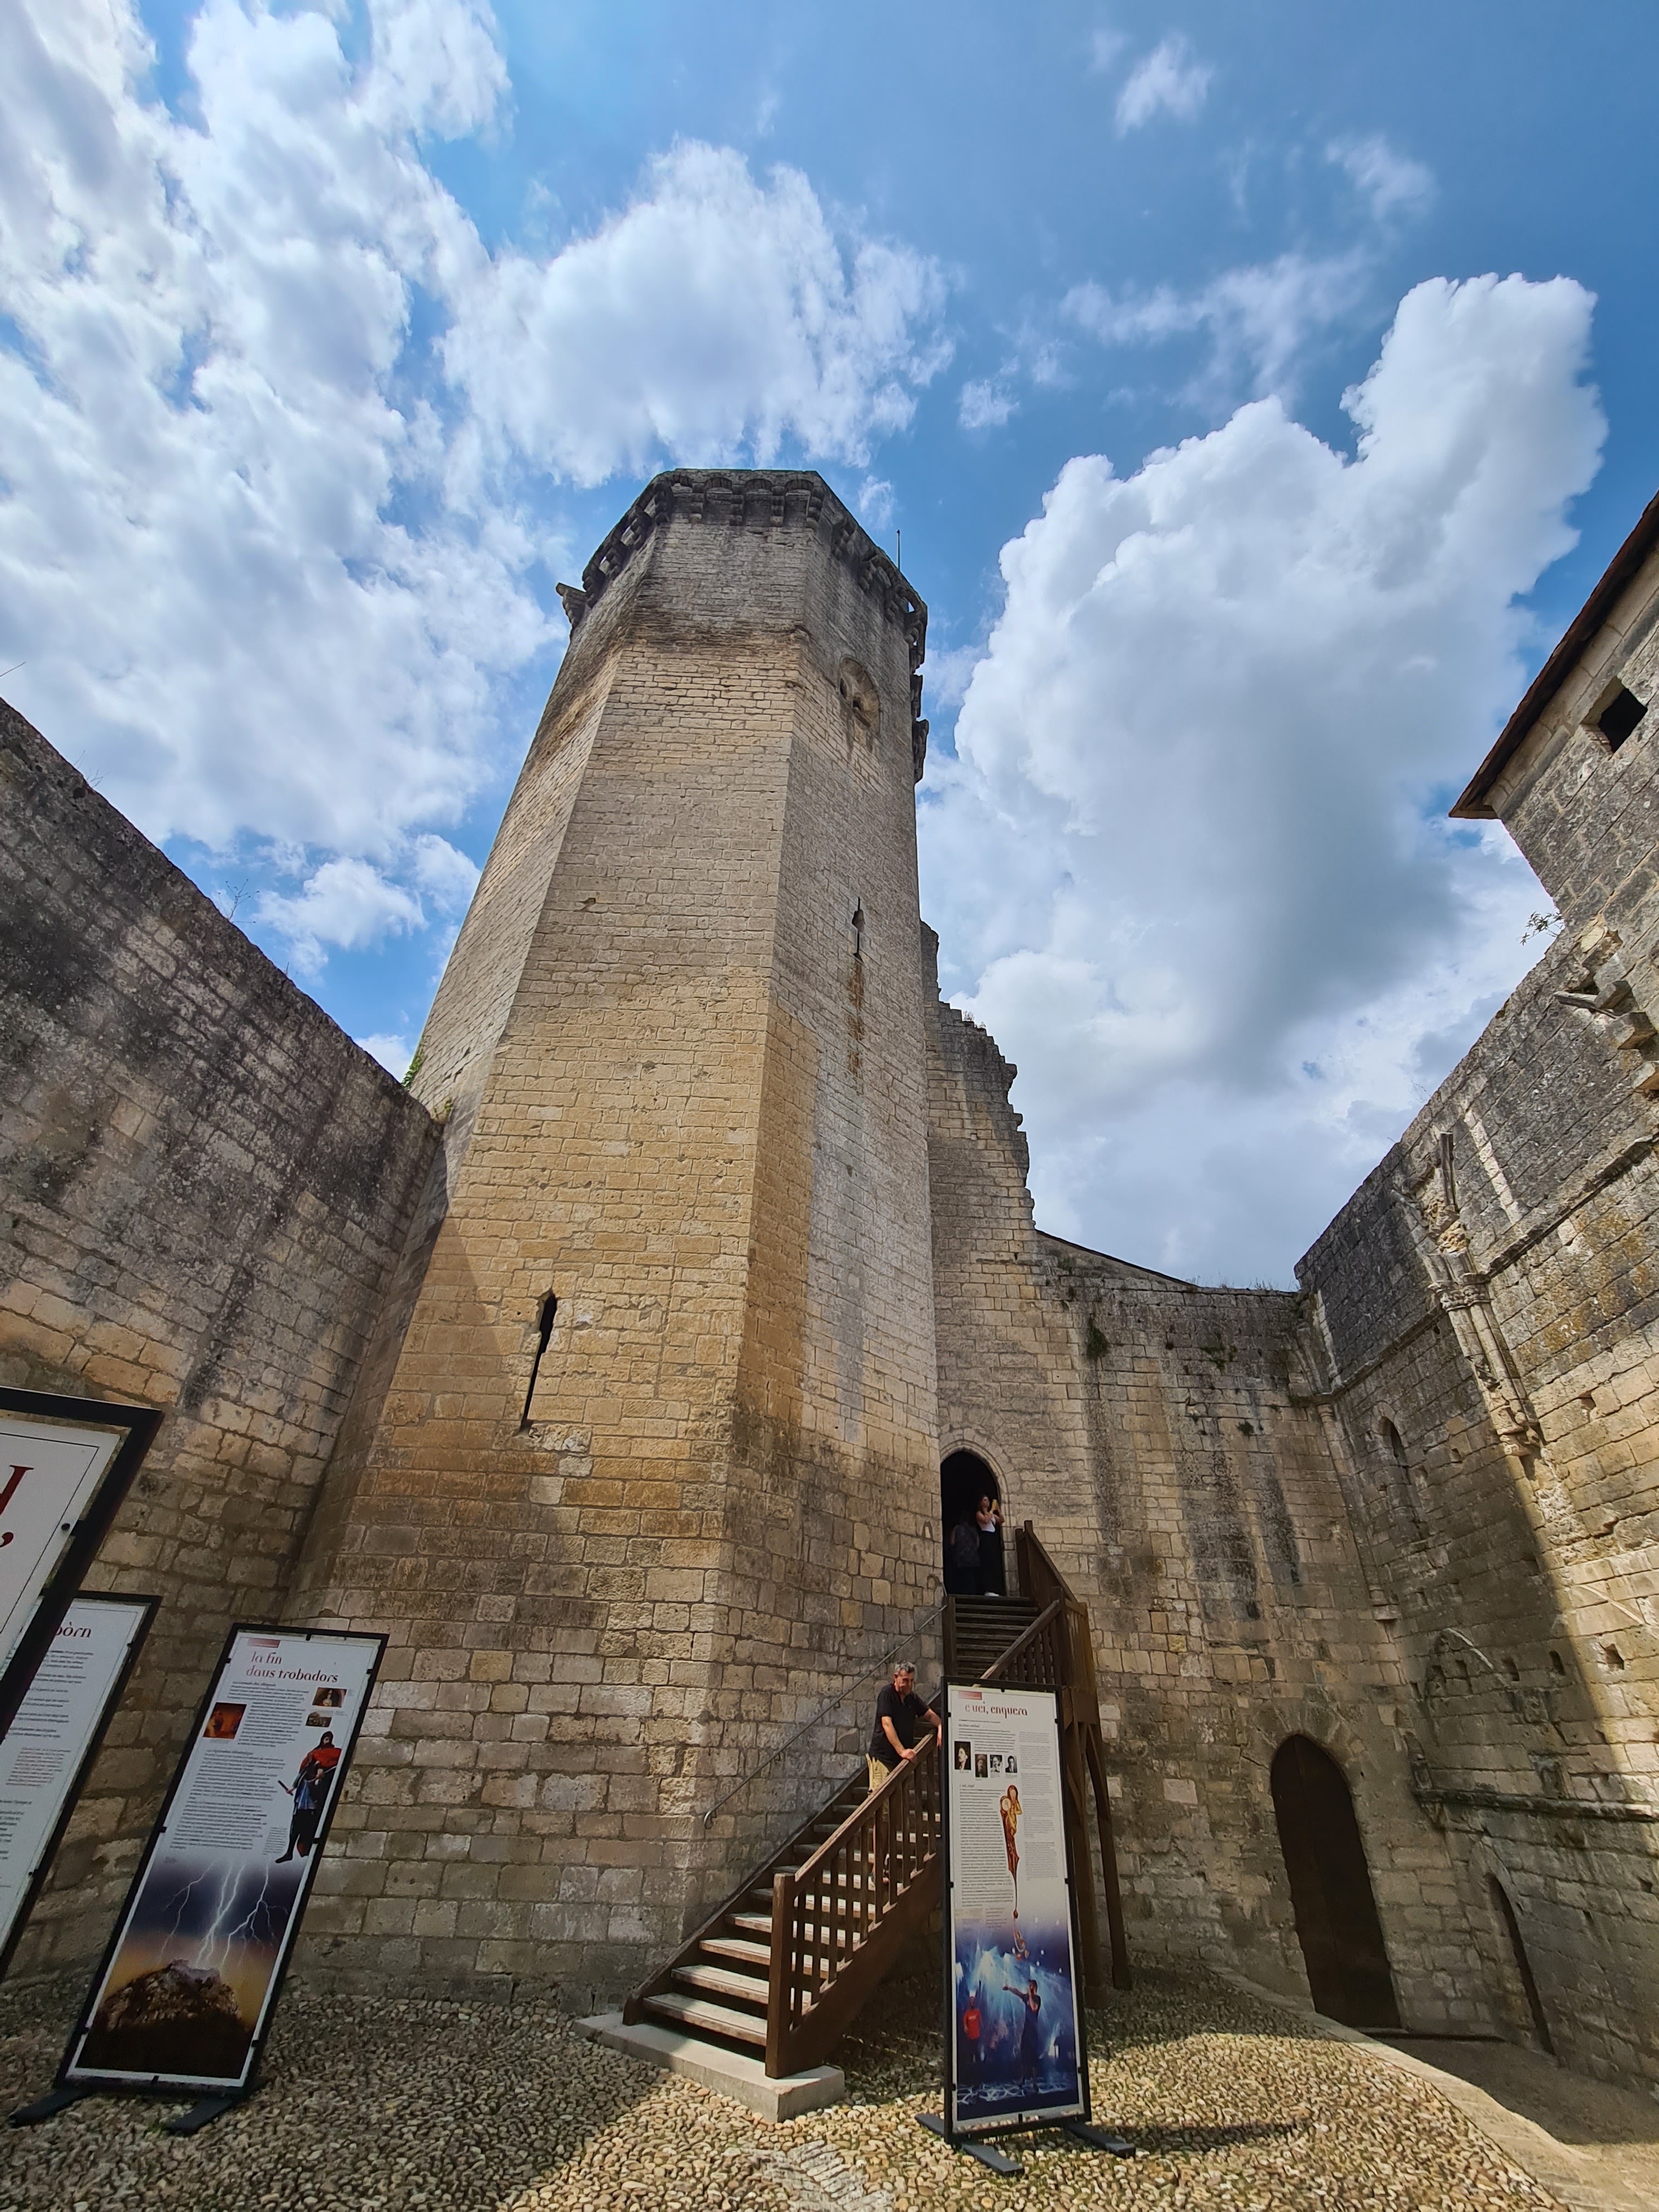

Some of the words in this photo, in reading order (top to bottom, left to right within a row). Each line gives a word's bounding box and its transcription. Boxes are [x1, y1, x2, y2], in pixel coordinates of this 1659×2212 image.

[251, 1651, 263, 1663] la
[266, 1651, 282, 1665] fin
[246, 1664, 275, 1679] daus
[278, 1668, 338, 1684] trobadors
[990, 1706, 1028, 1718] enquera
